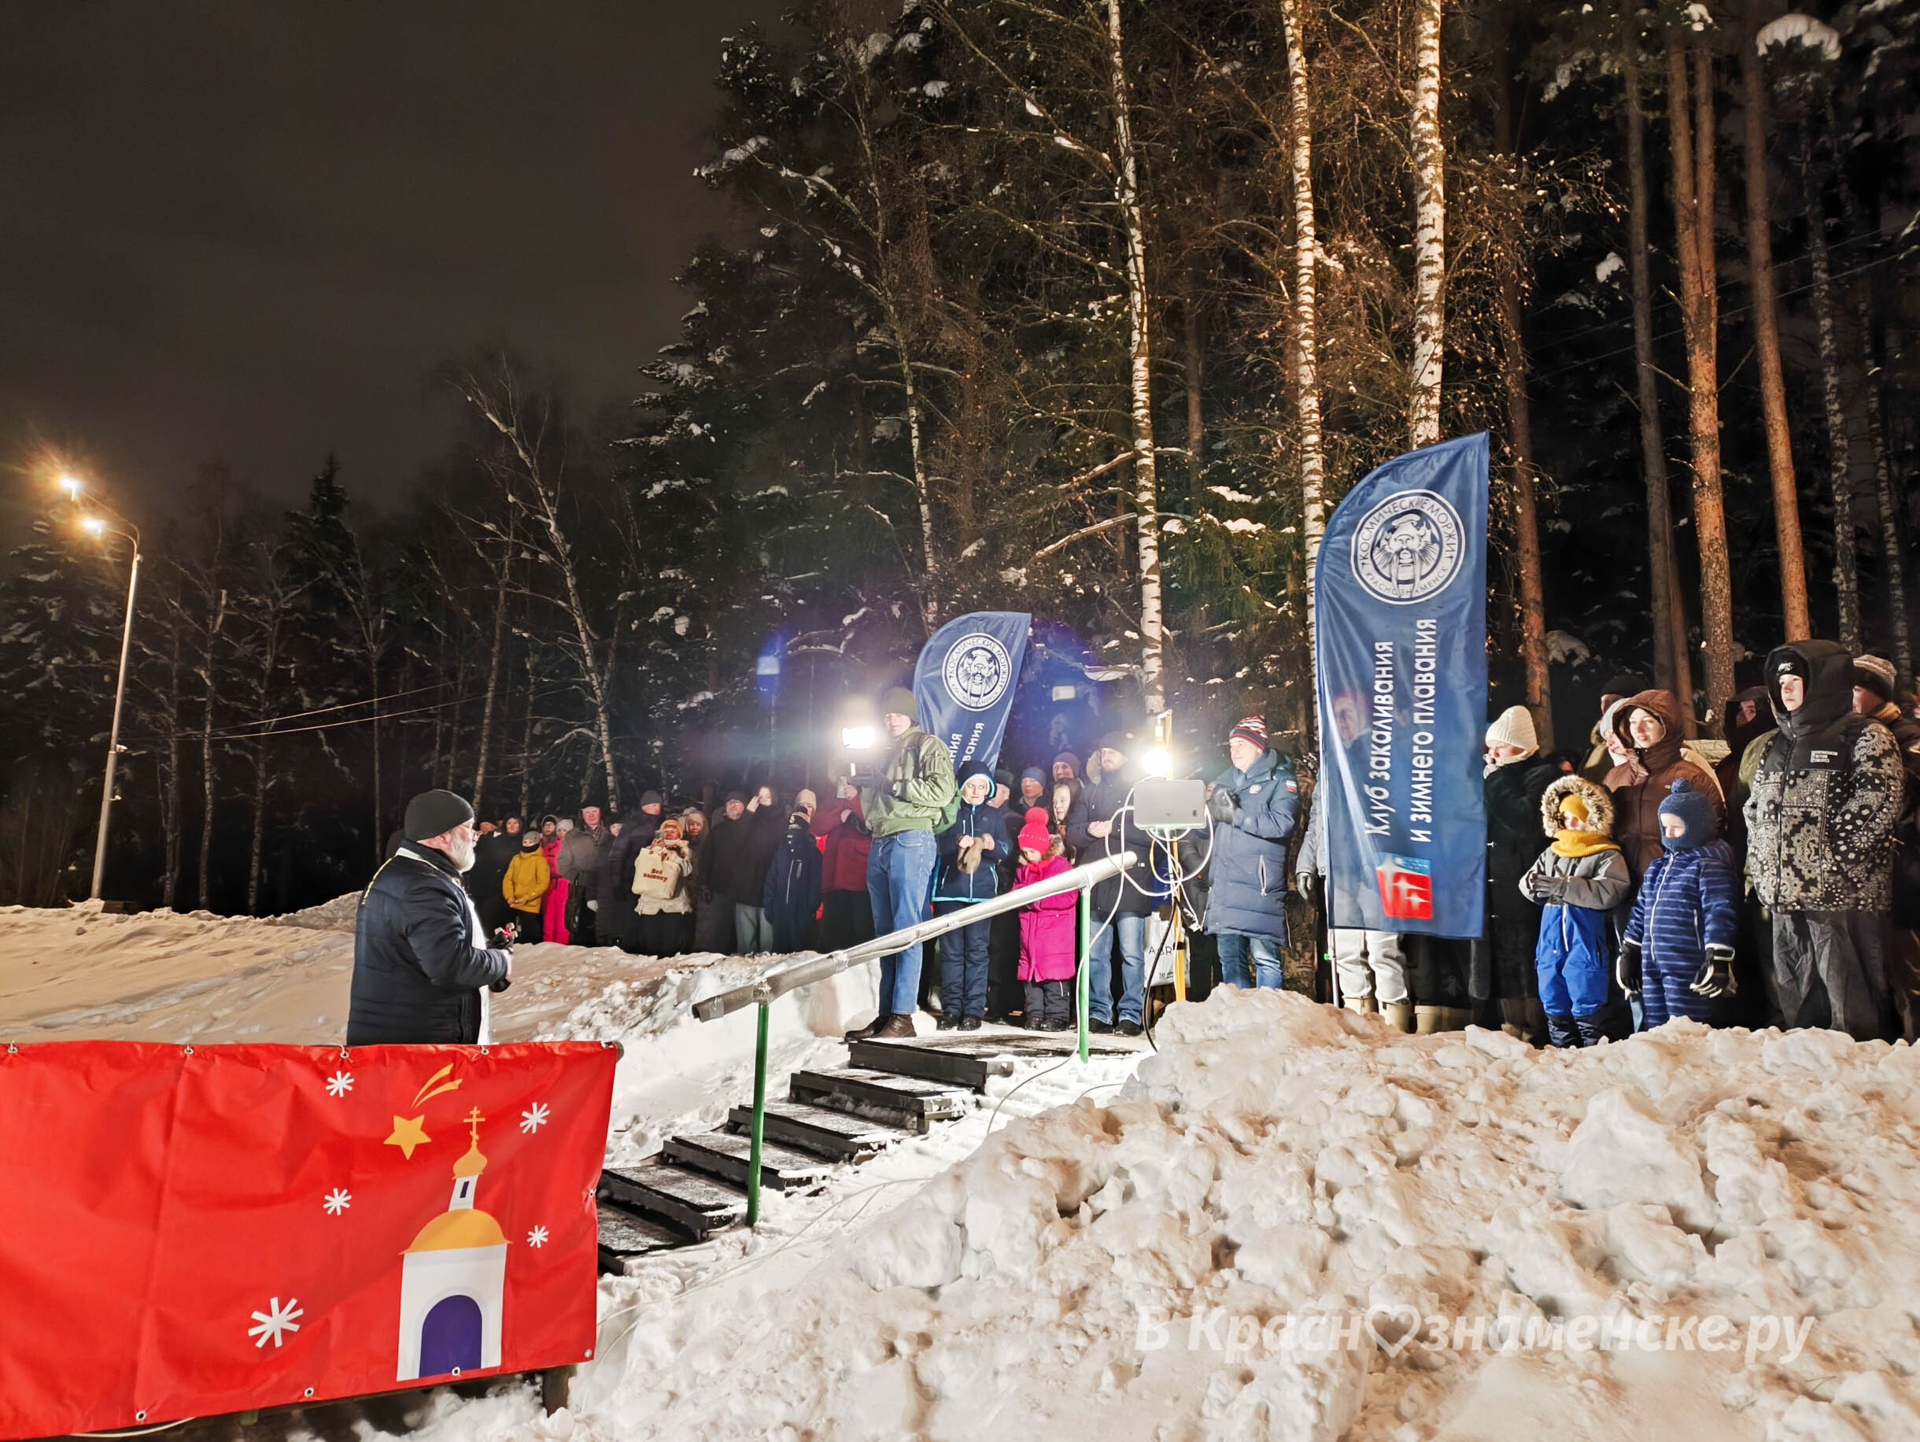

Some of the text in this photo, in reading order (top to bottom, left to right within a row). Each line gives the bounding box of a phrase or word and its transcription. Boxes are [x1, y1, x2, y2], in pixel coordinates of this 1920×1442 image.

[1359, 498, 1456, 560] КОСМИЧЕСКИЕ МОРЖИ
[1413, 618, 1437, 725] плавания
[1364, 641, 1396, 836] Клуб закаливания
[1411, 730, 1434, 824] зимнего
